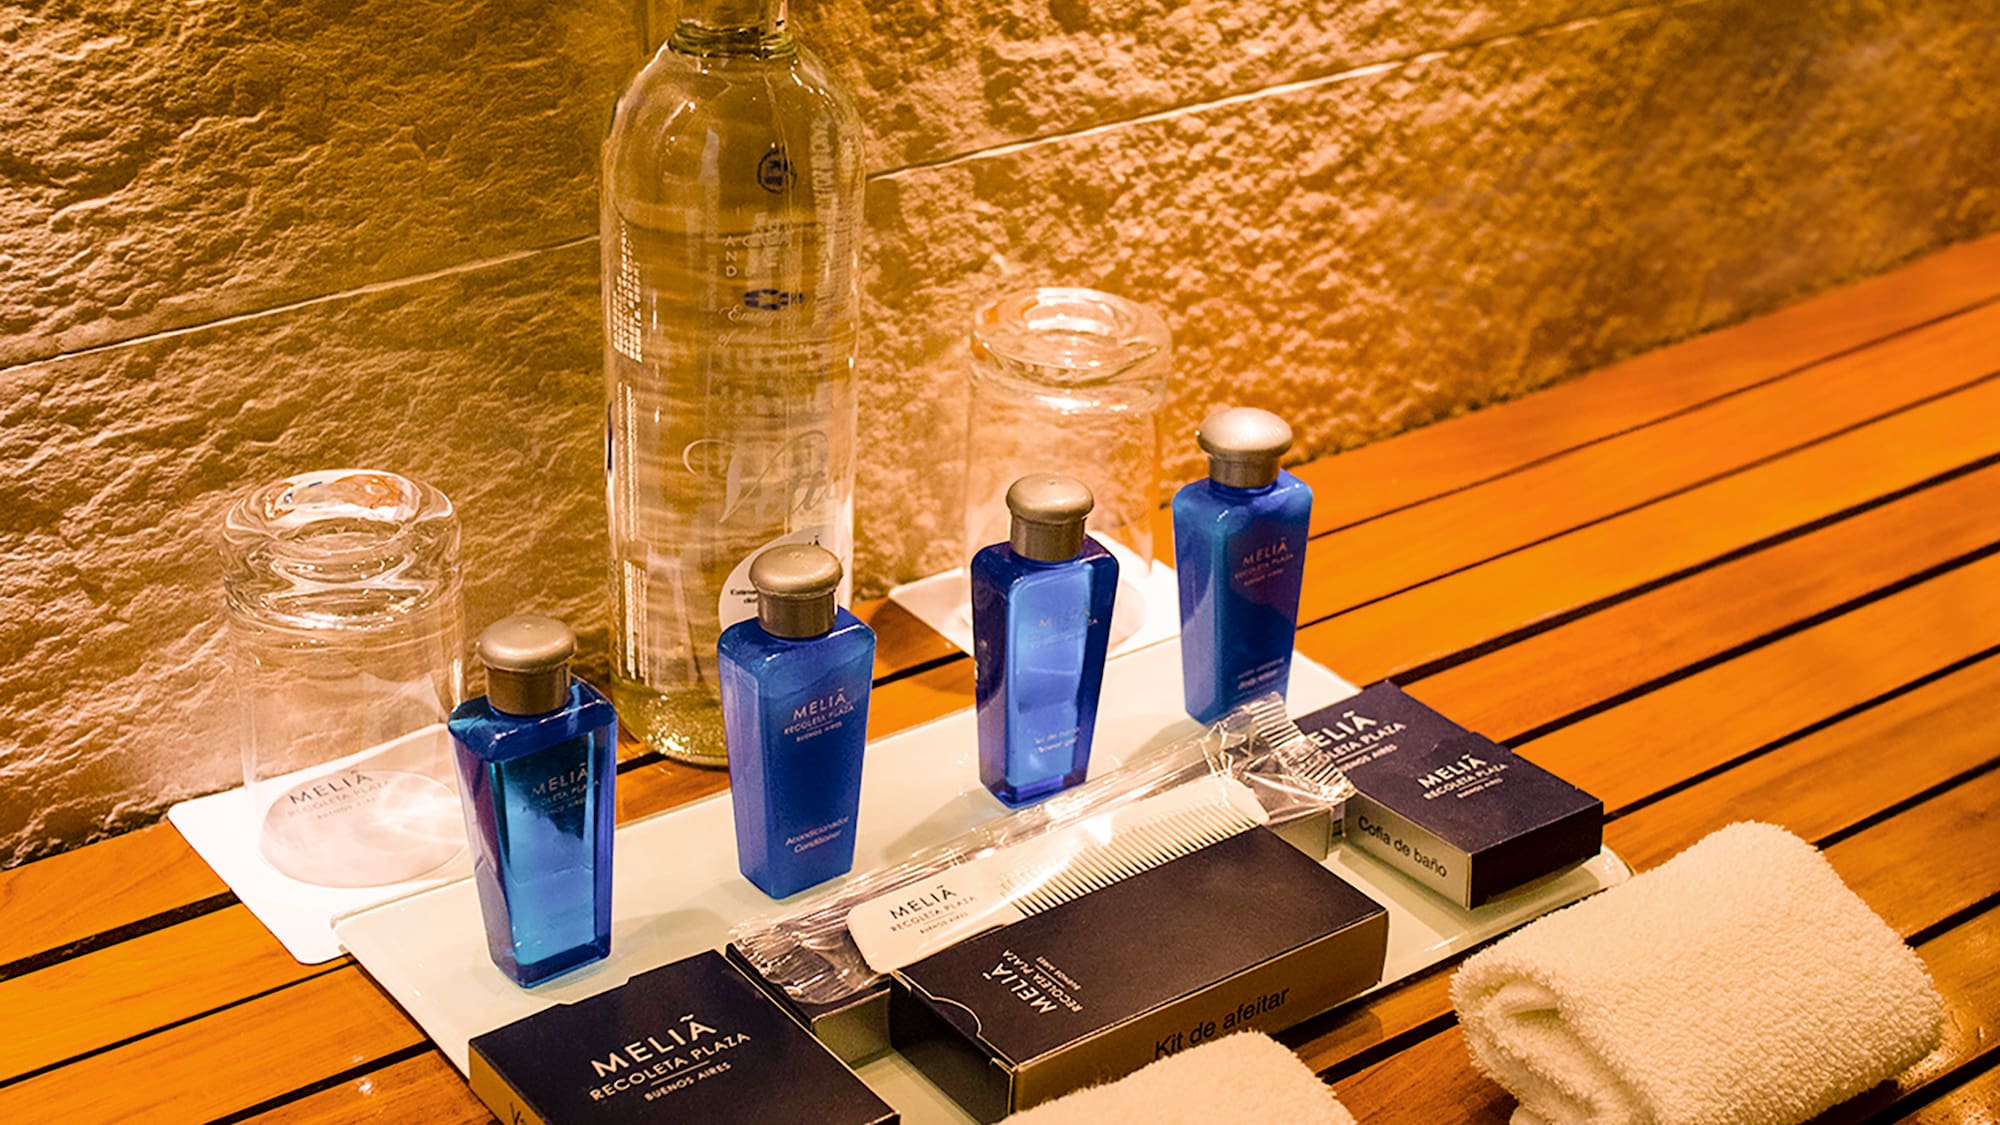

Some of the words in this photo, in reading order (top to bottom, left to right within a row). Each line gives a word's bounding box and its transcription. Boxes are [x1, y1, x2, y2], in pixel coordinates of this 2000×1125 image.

[784, 714, 827, 735] RECOLETA
[828, 704, 855, 720] PLAZA
[1360, 723, 1407, 745] PLAZA
[1372, 743, 1398, 758] AIRES
[1423, 774, 1477, 800] RECOLETA
[1475, 763, 1509, 778] PLAZA
[1358, 815, 1391, 846] Cofia
[1393, 839, 1411, 857] de
[1414, 847, 1448, 878] baño
[890, 908, 942, 932] RECOLETA
[943, 896, 976, 911] PLAZA
[1002, 949, 1035, 975] PLAZA
[1032, 973, 1083, 1013] RECOLETA
[1154, 1031, 1183, 1060] Kit
[1189, 1020, 1217, 1045] de
[1223, 988, 1290, 1030] afeitar
[589, 1056, 690, 1102] RECOLETA
[689, 1032, 752, 1061] PLAZA
[643, 1075, 695, 1102] BUENOS
[696, 1061, 732, 1081] AIRES
